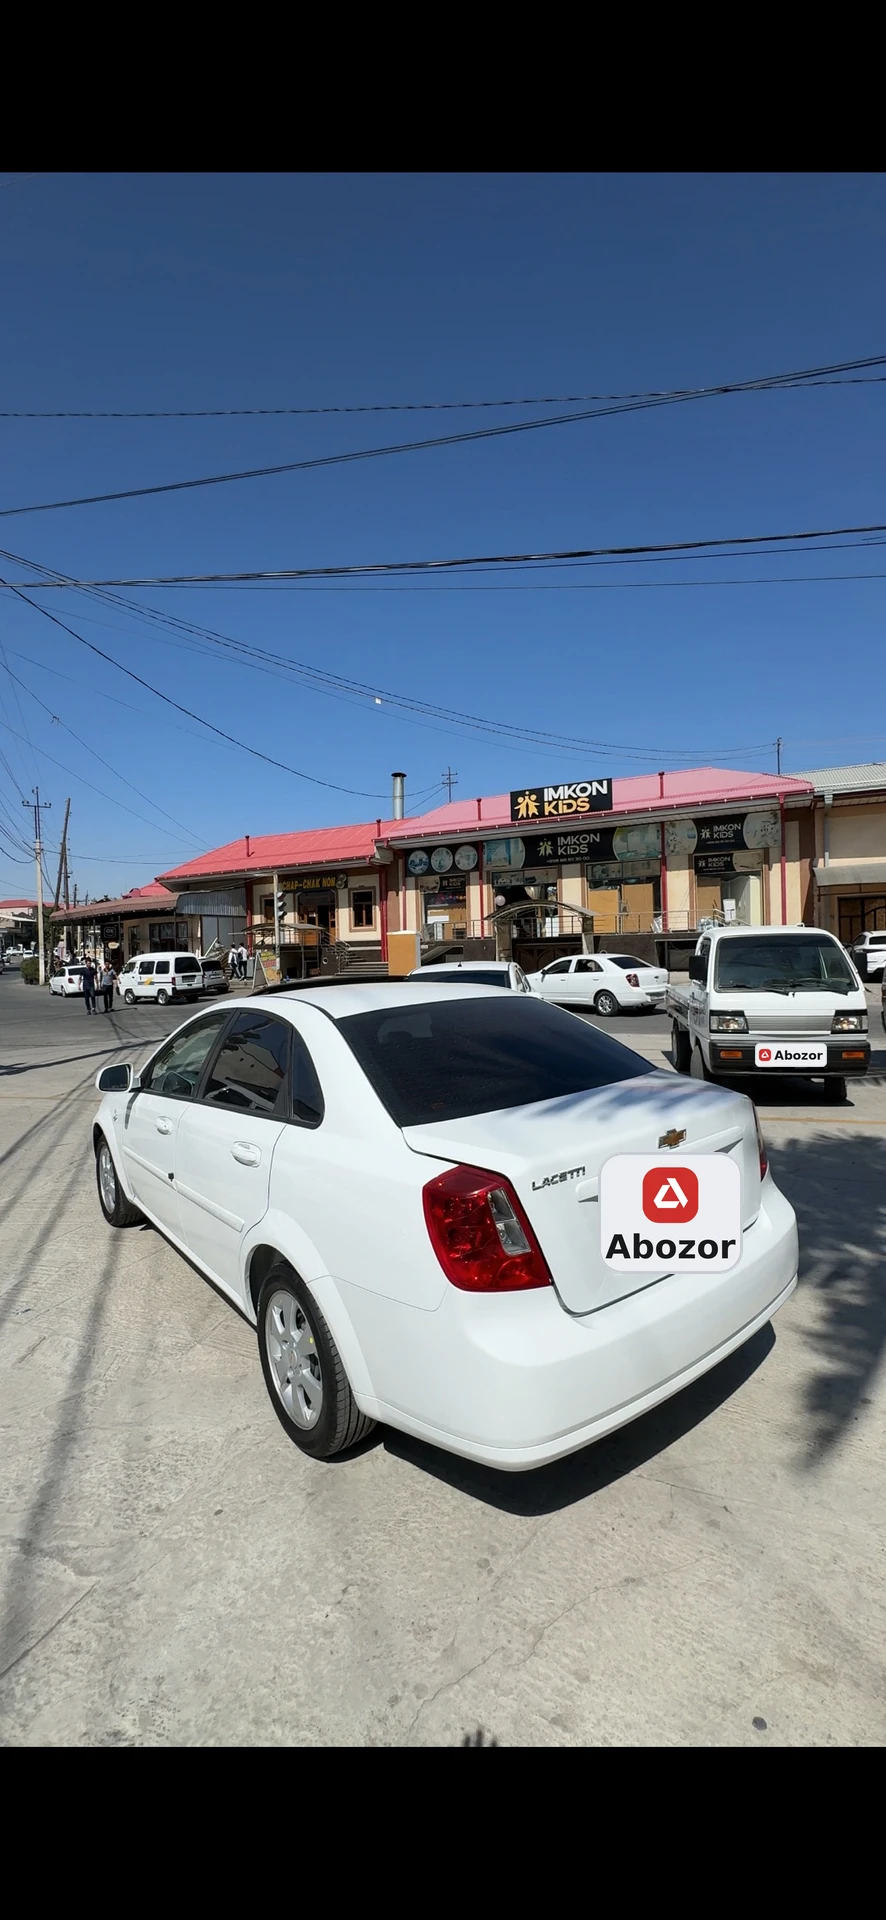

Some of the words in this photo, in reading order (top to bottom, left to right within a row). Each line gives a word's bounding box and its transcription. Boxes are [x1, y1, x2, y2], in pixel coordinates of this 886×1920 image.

[543, 780, 608, 802] IMKON
[544, 797, 590, 816] KIDS
[713, 824, 741, 832] IMKON
[557, 833, 600, 846] IMKON
[557, 844, 588, 856] KIDS
[282, 878, 320, 890] CHAP-CHAK
[322, 876, 336, 887] NON
[532, 1166, 586, 1191] LACETTI
